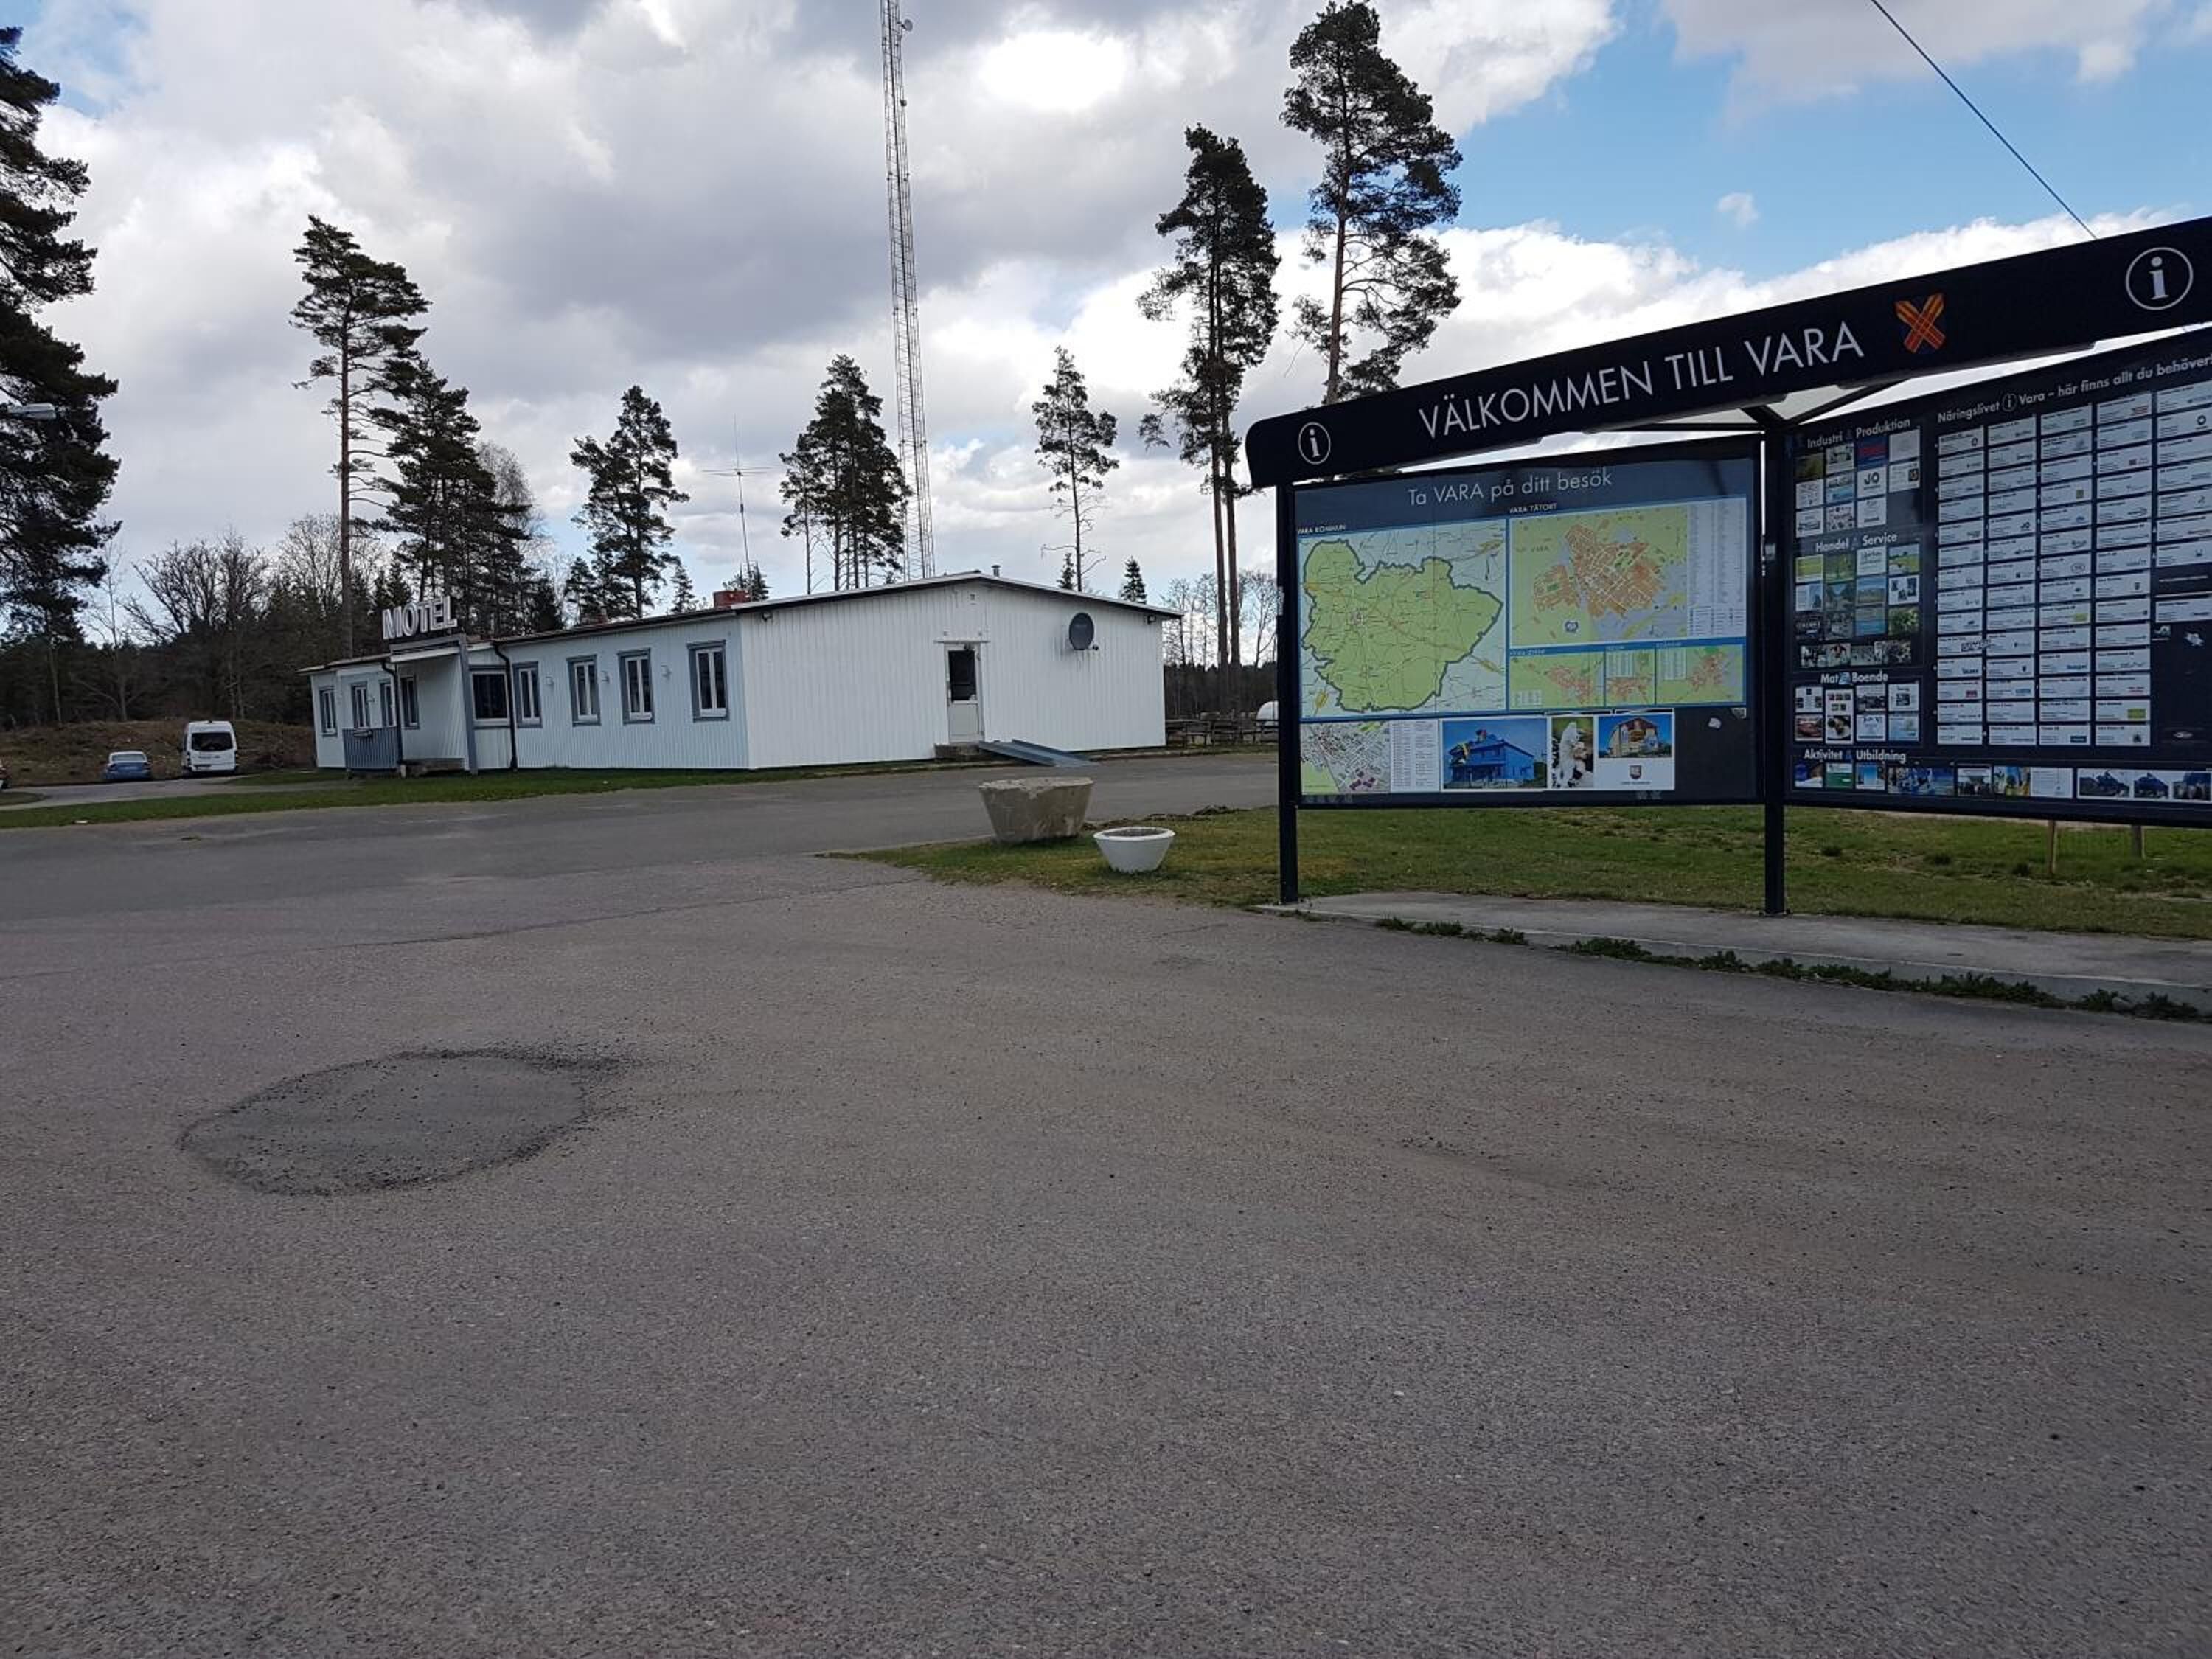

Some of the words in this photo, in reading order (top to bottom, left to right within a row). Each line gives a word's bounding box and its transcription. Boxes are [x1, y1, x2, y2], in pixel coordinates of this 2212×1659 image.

[1418, 361, 1652, 439] VÄLKOMMEN
[1664, 347, 1733, 390] TILL
[1744, 320, 1864, 376] VARA
[1938, 400, 2000, 424] Näringslivet
[2019, 392, 2045, 406] Vara
[2058, 385, 2078, 397] här
[2081, 378, 2110, 393] finns
[2113, 371, 2133, 387] allt
[2137, 366, 2153, 380] du
[1807, 431, 1843, 449] Industri
[1856, 419, 1910, 438] Produktion
[1408, 487, 1427, 506] Ta
[1433, 483, 1484, 503] VARA
[1491, 478, 1514, 503] på
[1522, 476, 1549, 494] ditt
[1557, 467, 1613, 490] besök
[1816, 538, 1849, 552] Handel
[1863, 533, 1898, 546] Service
[383, 596, 458, 639] MOTEL
[1820, 673, 1839, 684] Mat
[1851, 672, 1888, 683] Boende
[1856, 749, 1906, 763] Utbildning
